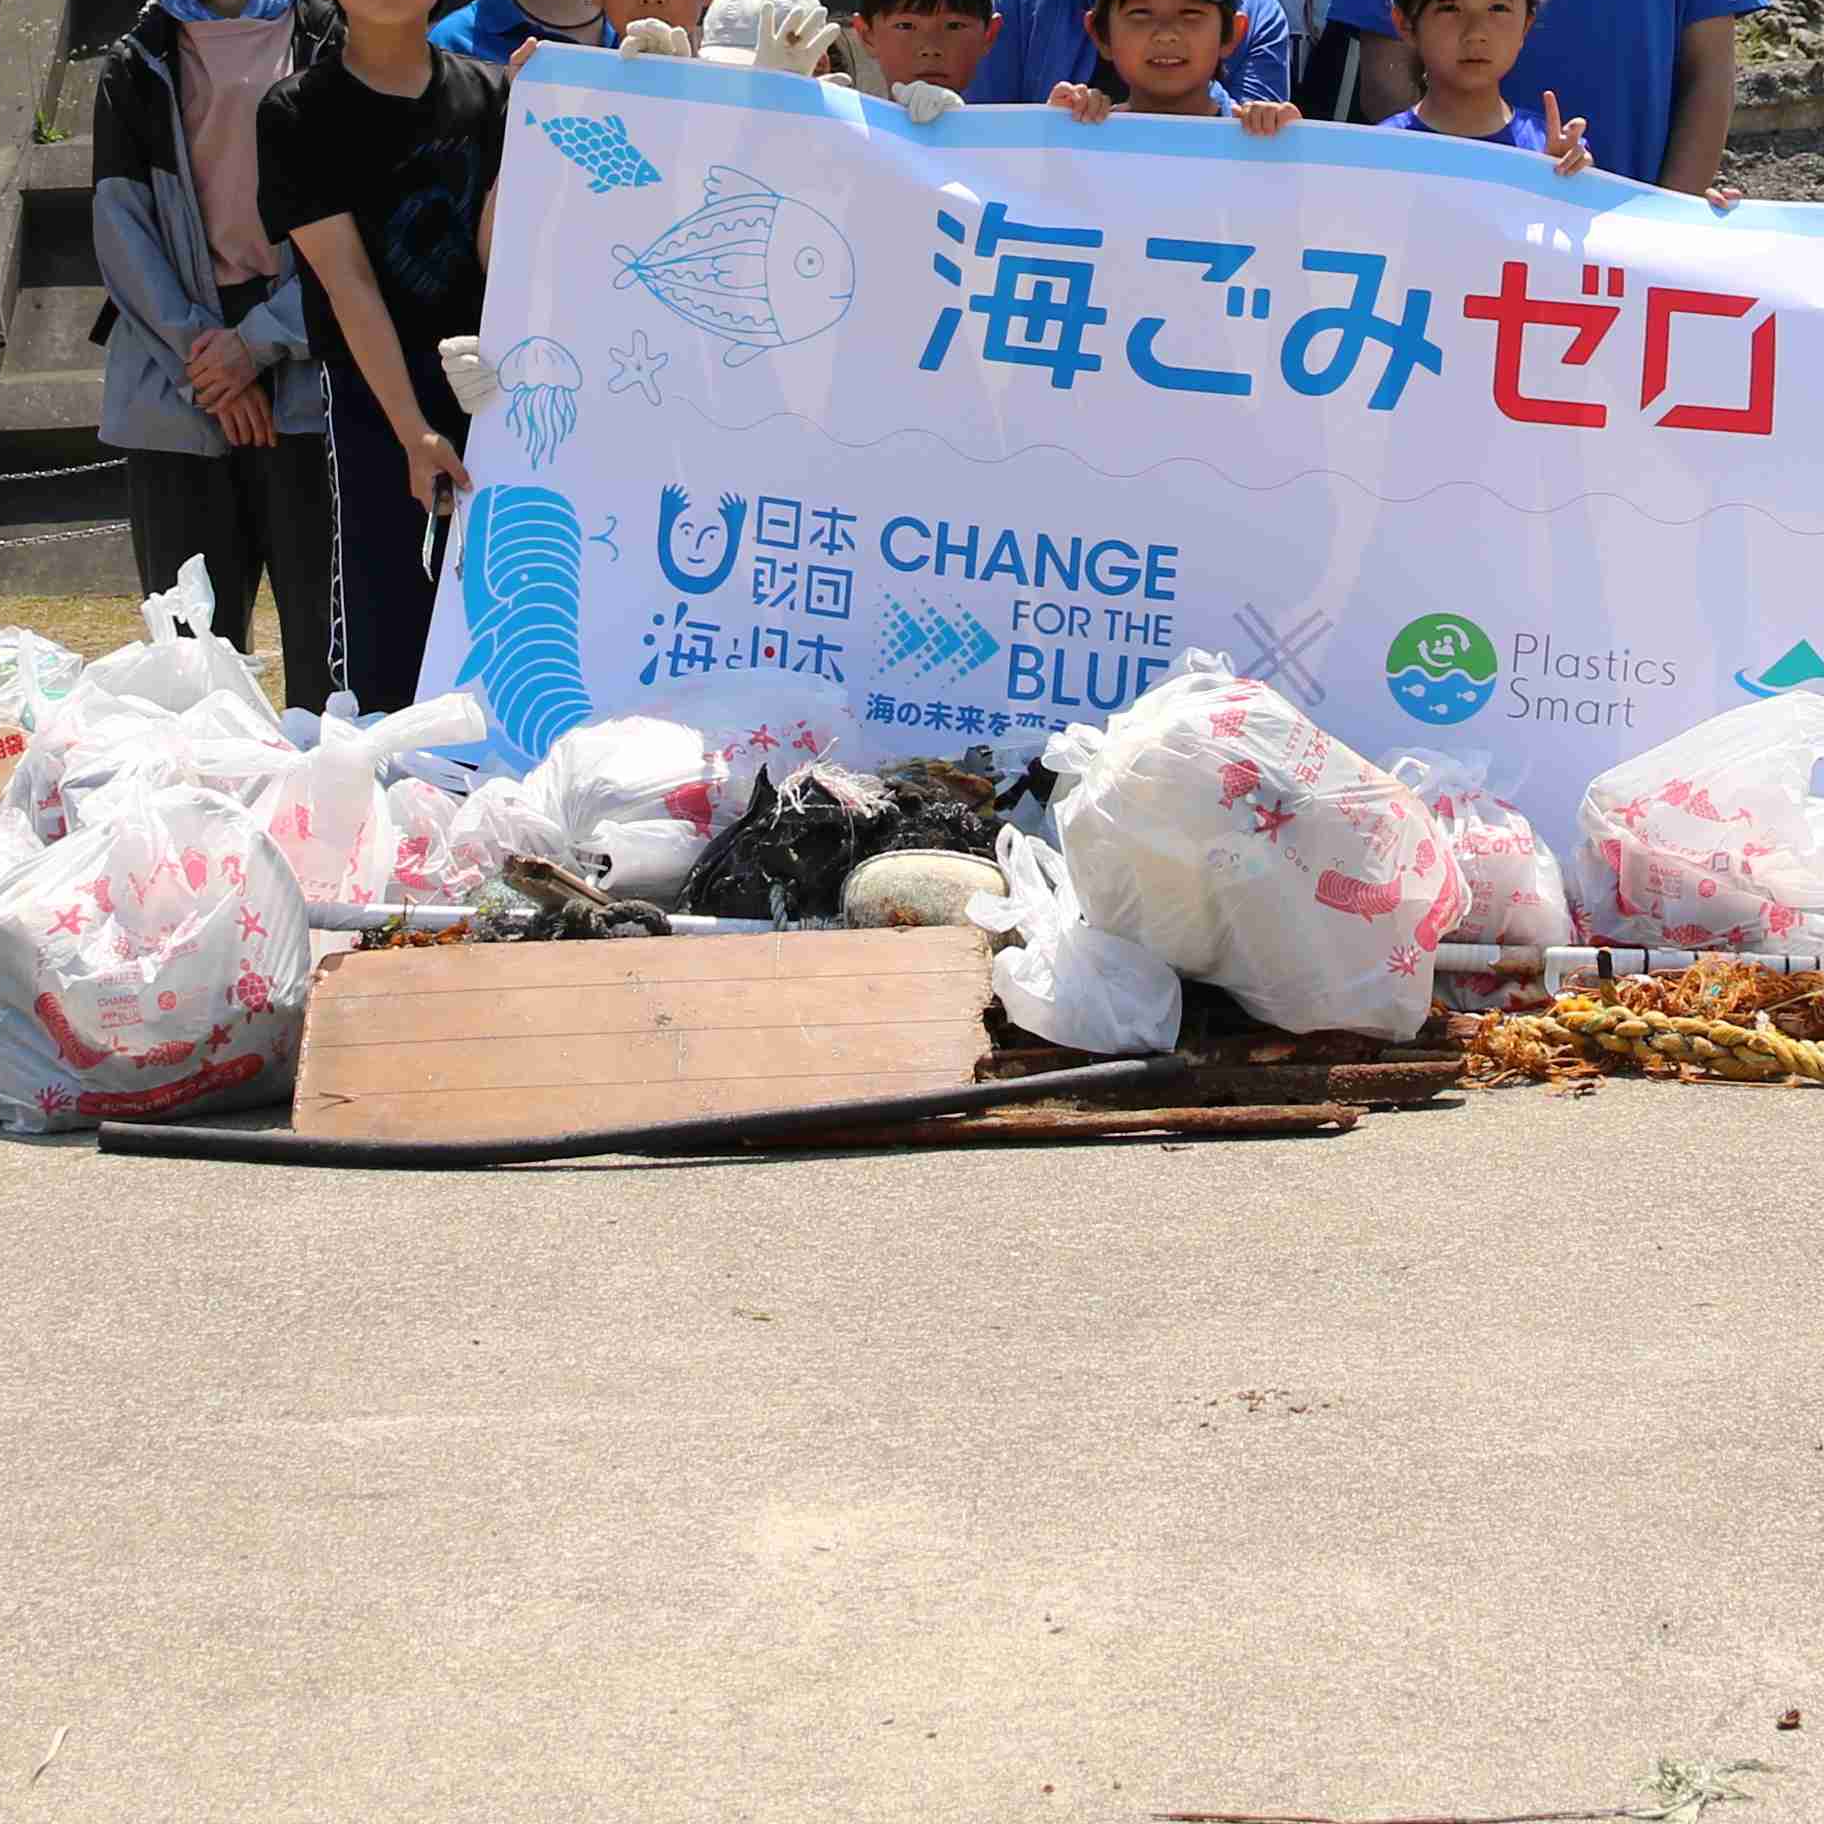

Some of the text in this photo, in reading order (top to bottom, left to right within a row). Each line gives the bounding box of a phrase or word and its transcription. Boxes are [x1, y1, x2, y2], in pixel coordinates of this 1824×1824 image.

[918, 201, 1776, 435] 海ごみゼロ
[756, 495, 858, 556] 日本
[753, 555, 854, 620] 財団
[879, 515, 1179, 602] CHANGE
[1011, 599, 1174, 648] FOR THE
[1512, 632, 1677, 688] Plastics
[1507, 676, 1636, 729] Smart
